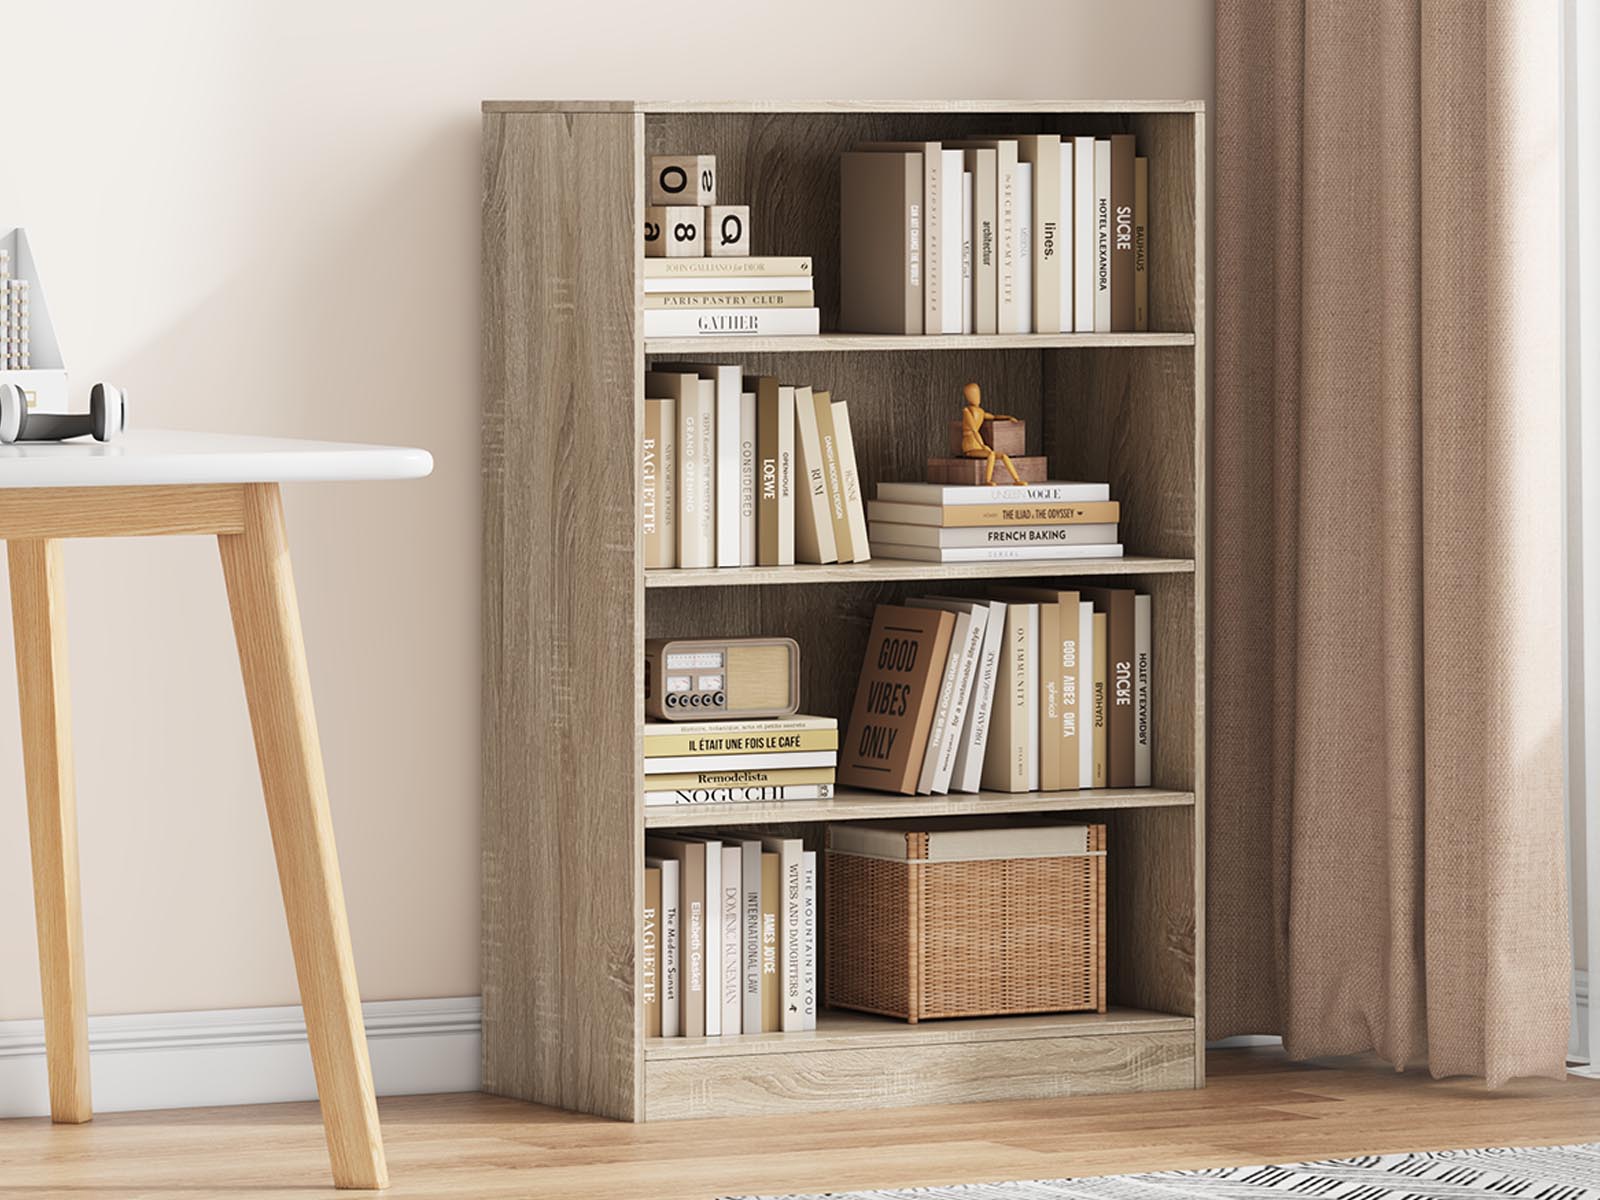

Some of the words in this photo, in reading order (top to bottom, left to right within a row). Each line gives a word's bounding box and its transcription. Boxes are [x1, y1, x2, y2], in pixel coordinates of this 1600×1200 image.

[1099, 198, 1108, 230] HOTEL
[1116, 206, 1131, 250] SUCRE
[674, 223, 696, 242] 8
[721, 215, 743, 246] Q
[1044, 222, 1056, 261] lines.
[1099, 231, 1108, 291] ALEXANDRA
[1136, 226, 1145, 272] BAUHAUS
[664, 297, 699, 305] PARIS
[703, 296, 748, 305] PASTRY
[752, 295, 784, 304] CLUB
[698, 316, 758, 330] GATHER
[686, 416, 694, 457] GRAND
[643, 439, 655, 534] BAGUETTE
[686, 462, 694, 512] OPENING
[743, 441, 752, 517] CONSIDERED
[763, 458, 775, 500] LOEWE
[1027, 488, 1061, 499] VOGUE
[1002, 510, 1013, 519] THE
[1035, 509, 1046, 519] THE
[1048, 509, 1074, 519] ODYSSEY
[988, 531, 1026, 541] FRENCH
[1029, 530, 1066, 540] BAKING
[1017, 627, 1024, 643] ON
[878, 638, 918, 672] GOOD
[866, 681, 910, 717] VIBES
[951, 713, 960, 727] for
[689, 740, 697, 751] IL
[699, 738, 723, 751] ÉTAIT
[725, 738, 742, 749] UNE
[745, 737, 764, 749] FOIS
[766, 737, 776, 748] LE
[778, 734, 800, 748] CAFÉ
[859, 725, 898, 760] ONLY
[698, 772, 768, 784] Remodelista
[675, 786, 784, 804] NOGUCHI
[789, 864, 799, 900] WIVES
[805, 870, 813, 890] THE
[667, 908, 676, 925] The
[691, 901, 701, 951] Elizabeth
[748, 891, 758, 969] INTERNATIONAL
[764, 913, 775, 943] JAMES
[789, 902, 799, 927] AND
[667, 928, 676, 964] Modern
[805, 898, 813, 968] MOUNTAIN
[643, 908, 655, 1004] BAGUETTE
[764, 944, 775, 974] JOYCE
[789, 929, 799, 998] DAUGHTERS
[667, 967, 676, 1000] Sunset
[691, 953, 701, 992] Gaskell
[748, 972, 758, 994] LAW
[805, 973, 813, 984] IS
[805, 988, 813, 1015] YOU
